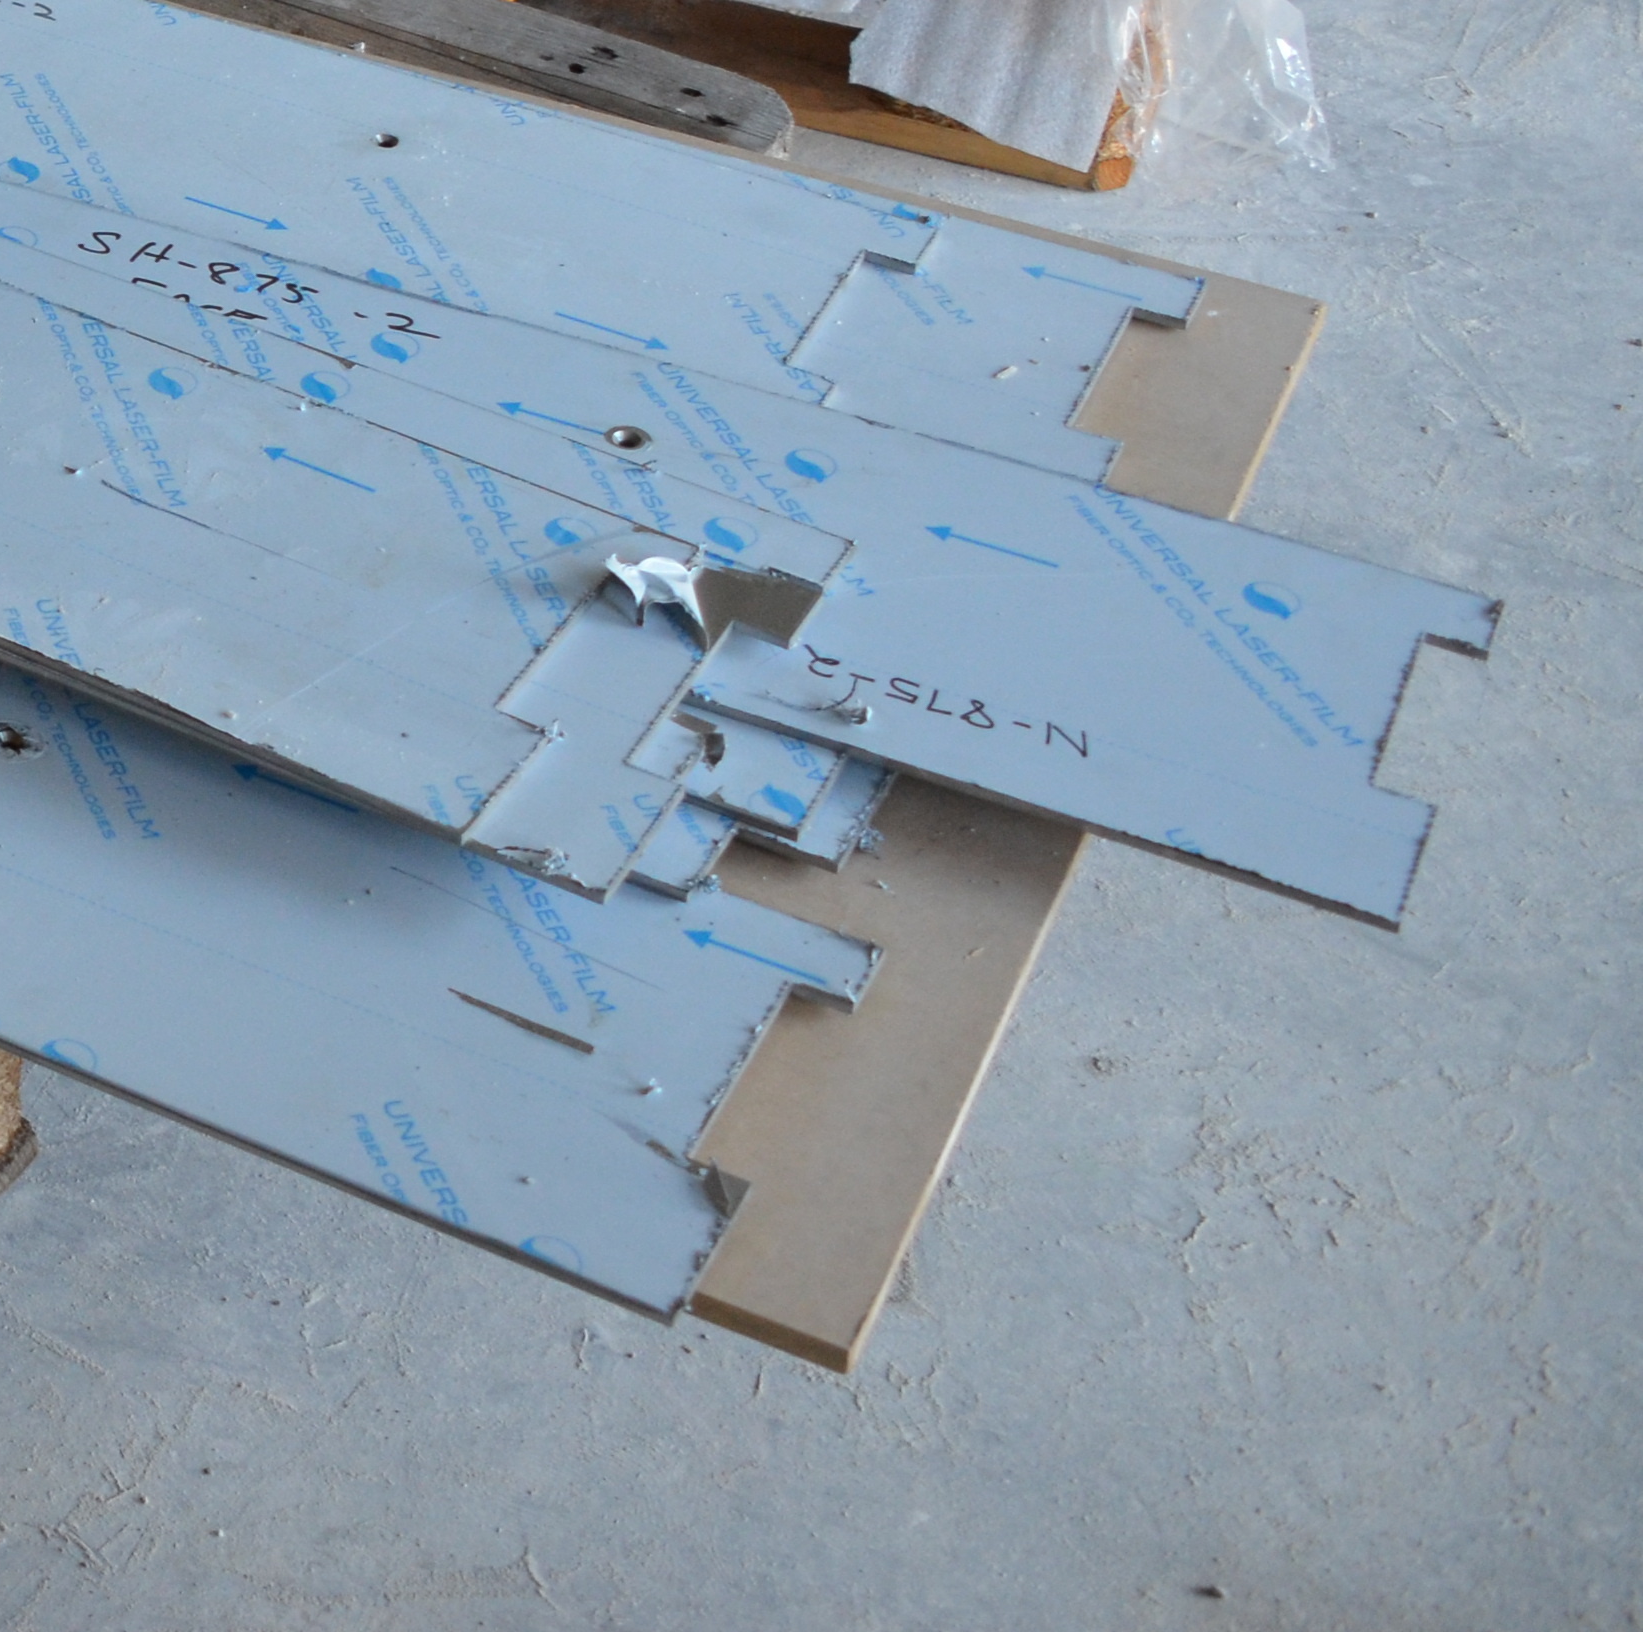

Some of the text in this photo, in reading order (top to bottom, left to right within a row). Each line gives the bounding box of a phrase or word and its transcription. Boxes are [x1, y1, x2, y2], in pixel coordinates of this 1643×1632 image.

[0, 73, 70, 167] LASER-FILM
[78, 231, 441, 339] SH-875-2
[346, 177, 432, 281] LASER-FILM
[115, 387, 187, 507] LASER-FILM
[632, 371, 667, 408] FIBER
[664, 410, 703, 452] OPTIC
[656, 361, 760, 472] UNIVERSAL
[1064, 494, 1109, 537] FIBER
[1107, 537, 1155, 585] OPTIC
[1198, 629, 1319, 748] TECHNOLOGIES
[1094, 483, 1364, 747] UNIVERSAL LASER-FILM
[50, 722, 116, 840] TECHNOLOGIES
[73, 702, 161, 840] LASER-FILM
[481, 884, 568, 1014] TECHNOLOGIES
[351, 1113, 388, 1168] FIBER
